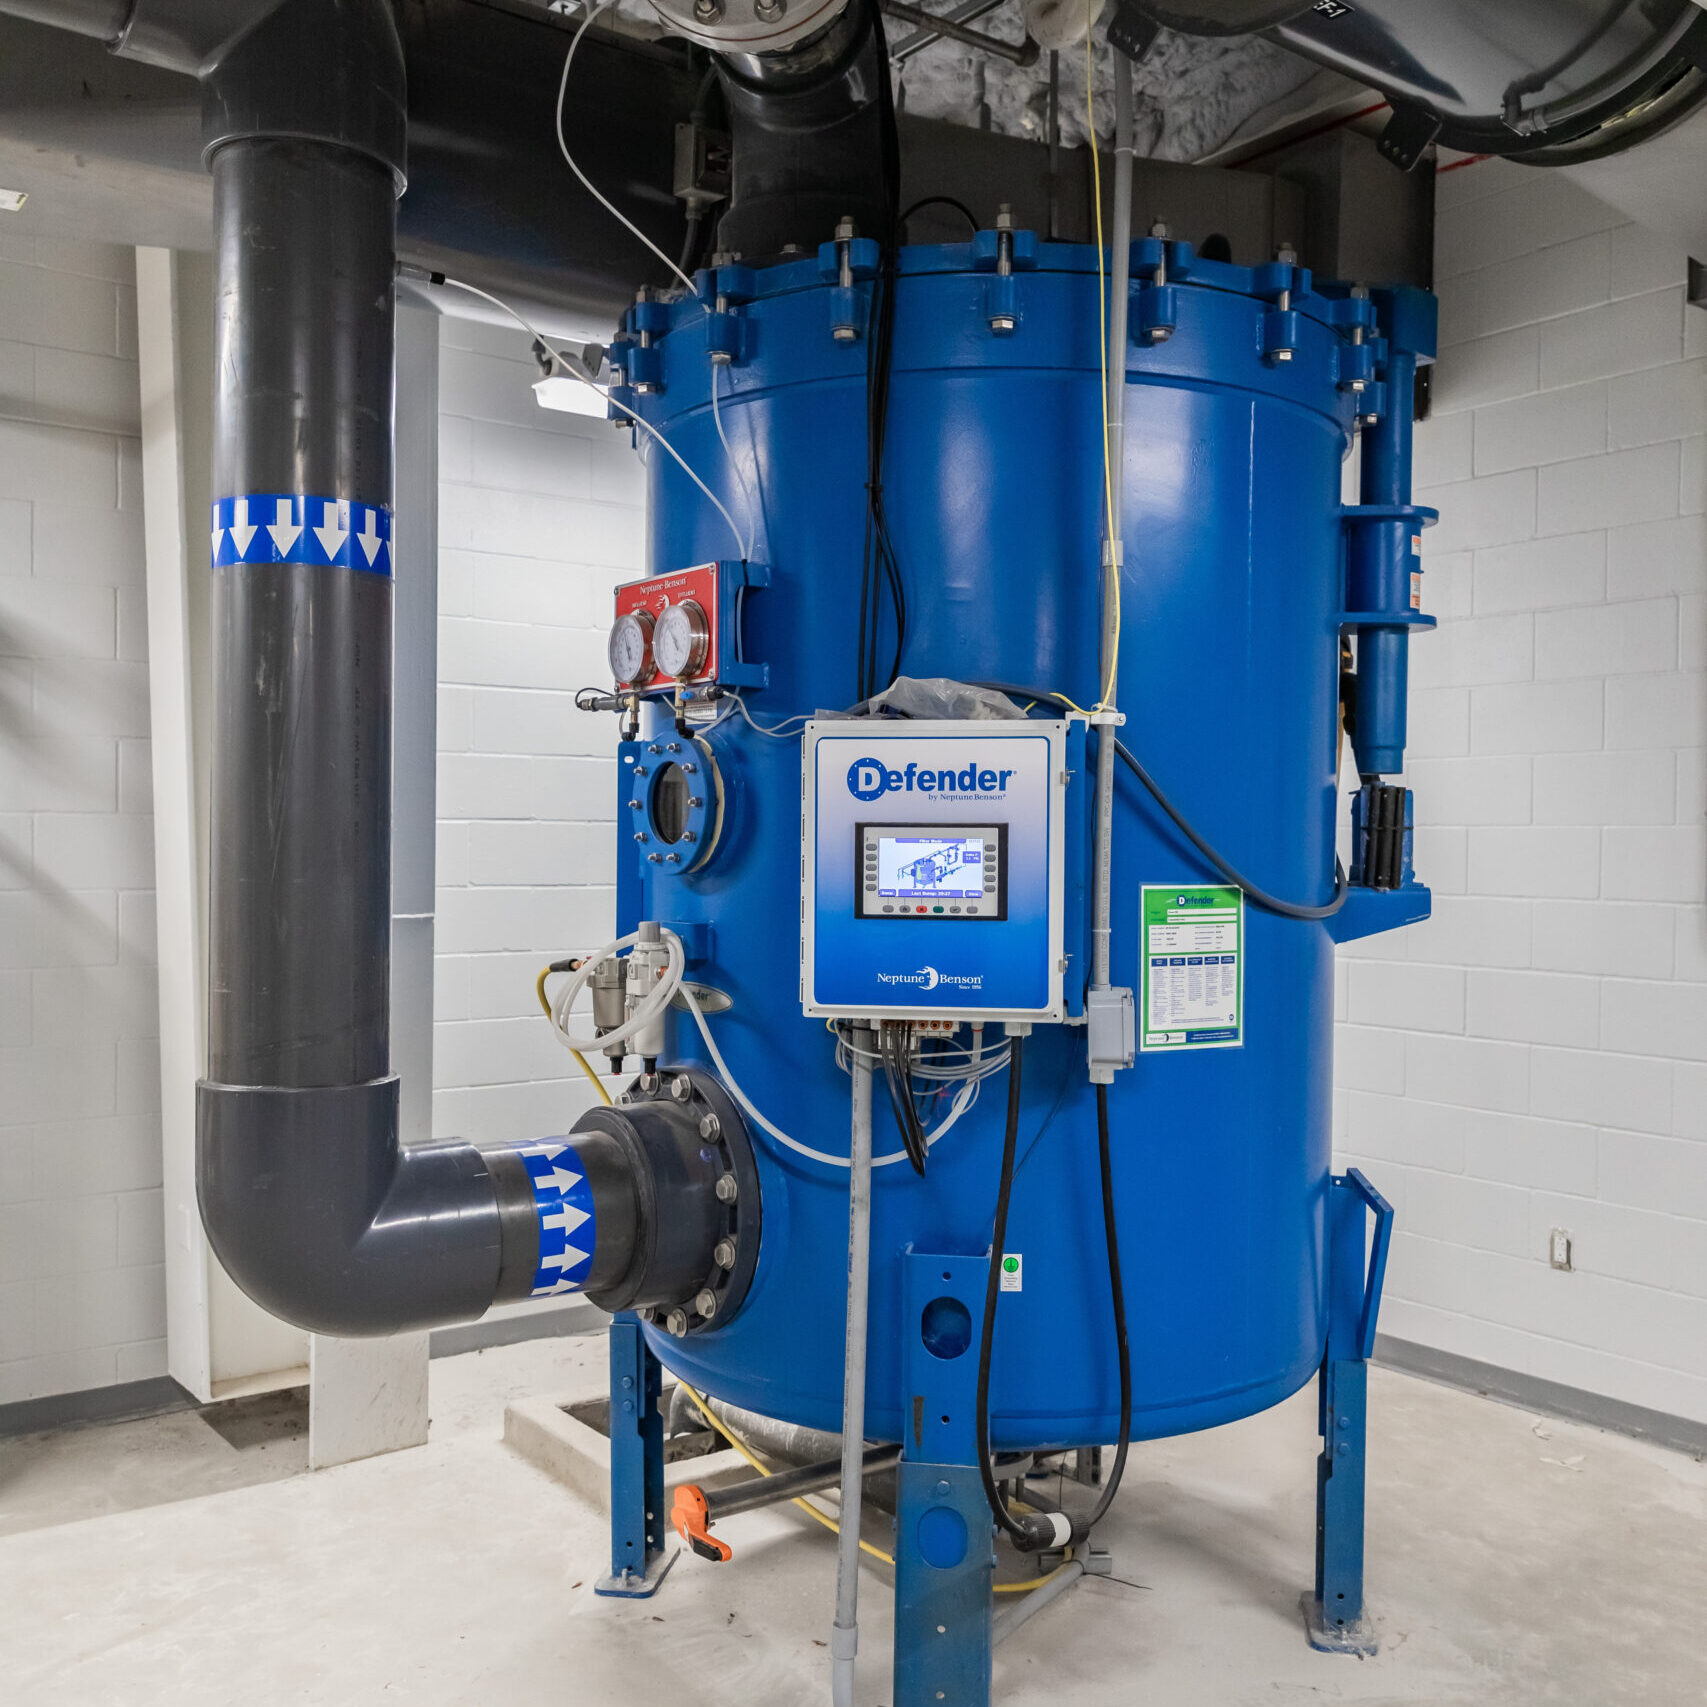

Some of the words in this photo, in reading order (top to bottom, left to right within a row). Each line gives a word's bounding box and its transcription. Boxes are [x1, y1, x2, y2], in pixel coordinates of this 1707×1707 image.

[854, 761, 1012, 793] Defender
[928, 793, 938, 801] by
[940, 793, 973, 802] Neptune
[1177, 895, 1215, 906] Defender
[877, 973, 925, 985] Neptune
[940, 974, 981, 984] Benson
